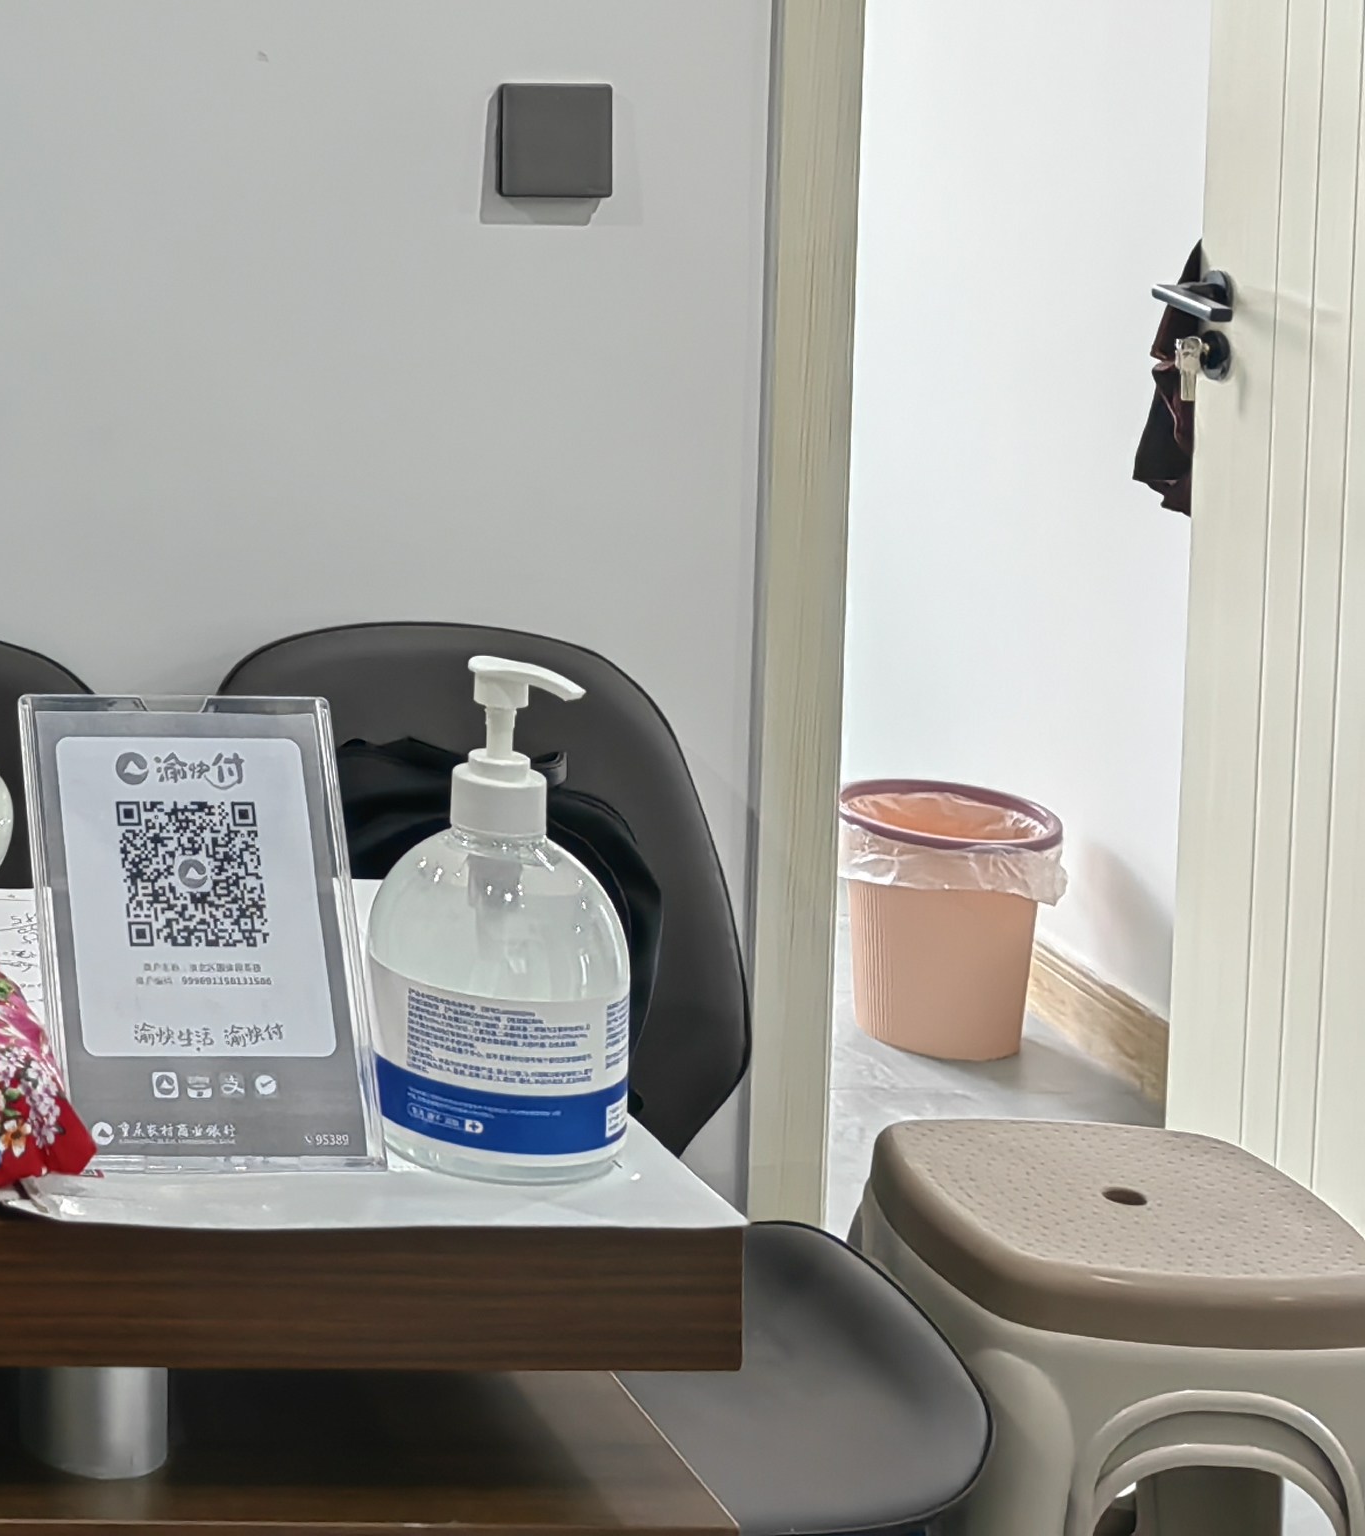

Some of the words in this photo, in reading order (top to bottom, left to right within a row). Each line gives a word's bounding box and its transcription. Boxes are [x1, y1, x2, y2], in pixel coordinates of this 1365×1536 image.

[153, 752, 245, 790] 渝快付
[315, 1133, 350, 1146] 95389
